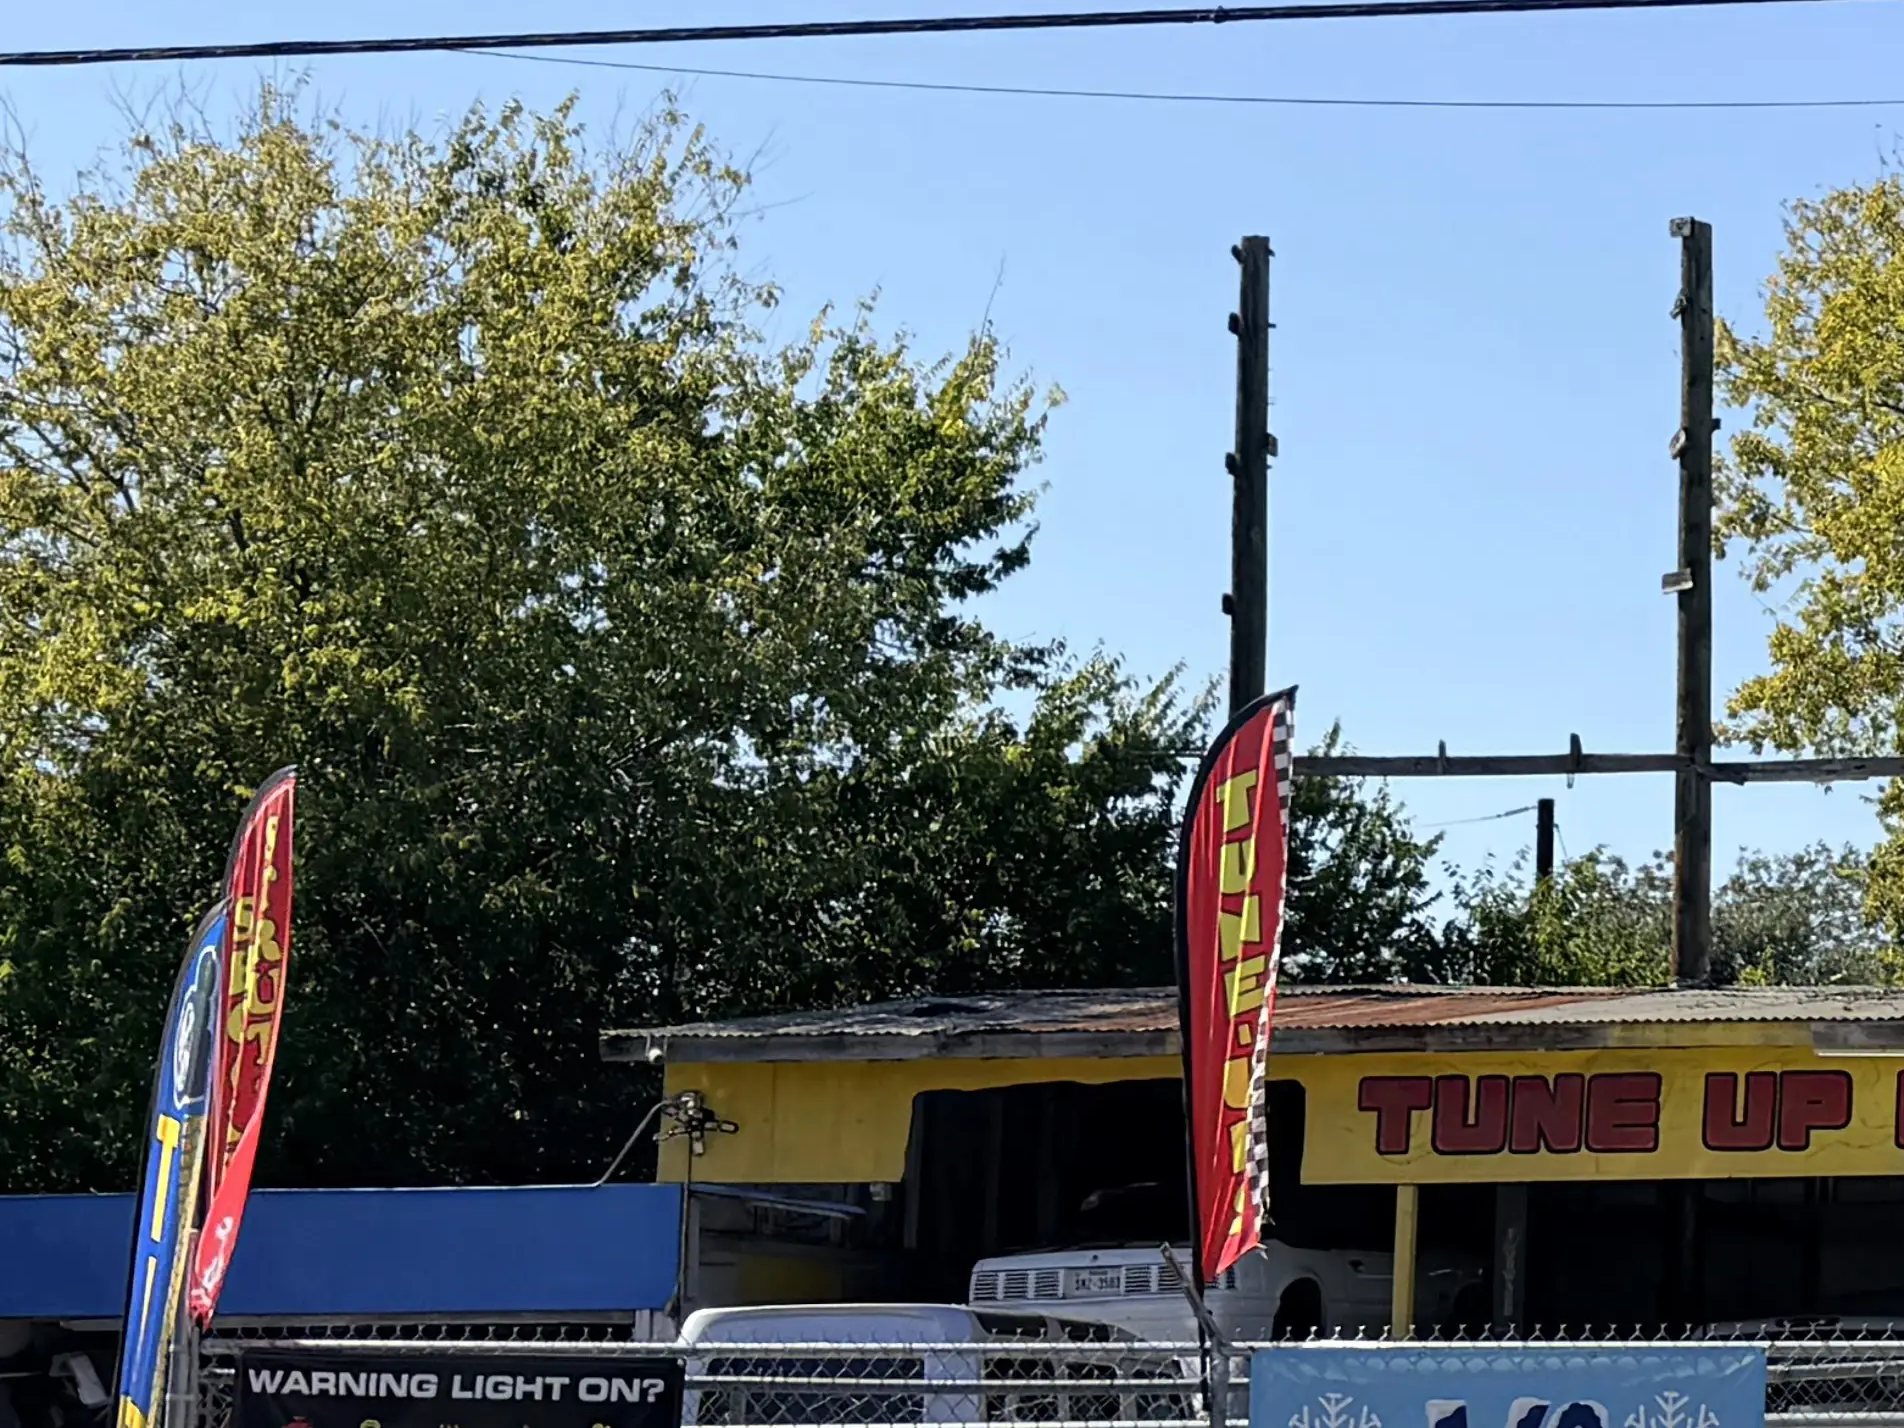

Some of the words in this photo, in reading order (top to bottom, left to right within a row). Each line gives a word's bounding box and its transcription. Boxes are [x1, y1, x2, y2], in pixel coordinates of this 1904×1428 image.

[1357, 1070, 1662, 1155] TUNE
[1703, 1068, 1853, 1153] UP
[248, 1368, 439, 1400] WARNING
[451, 1374, 570, 1402] LIGHT
[577, 1376, 666, 1404] ON?
